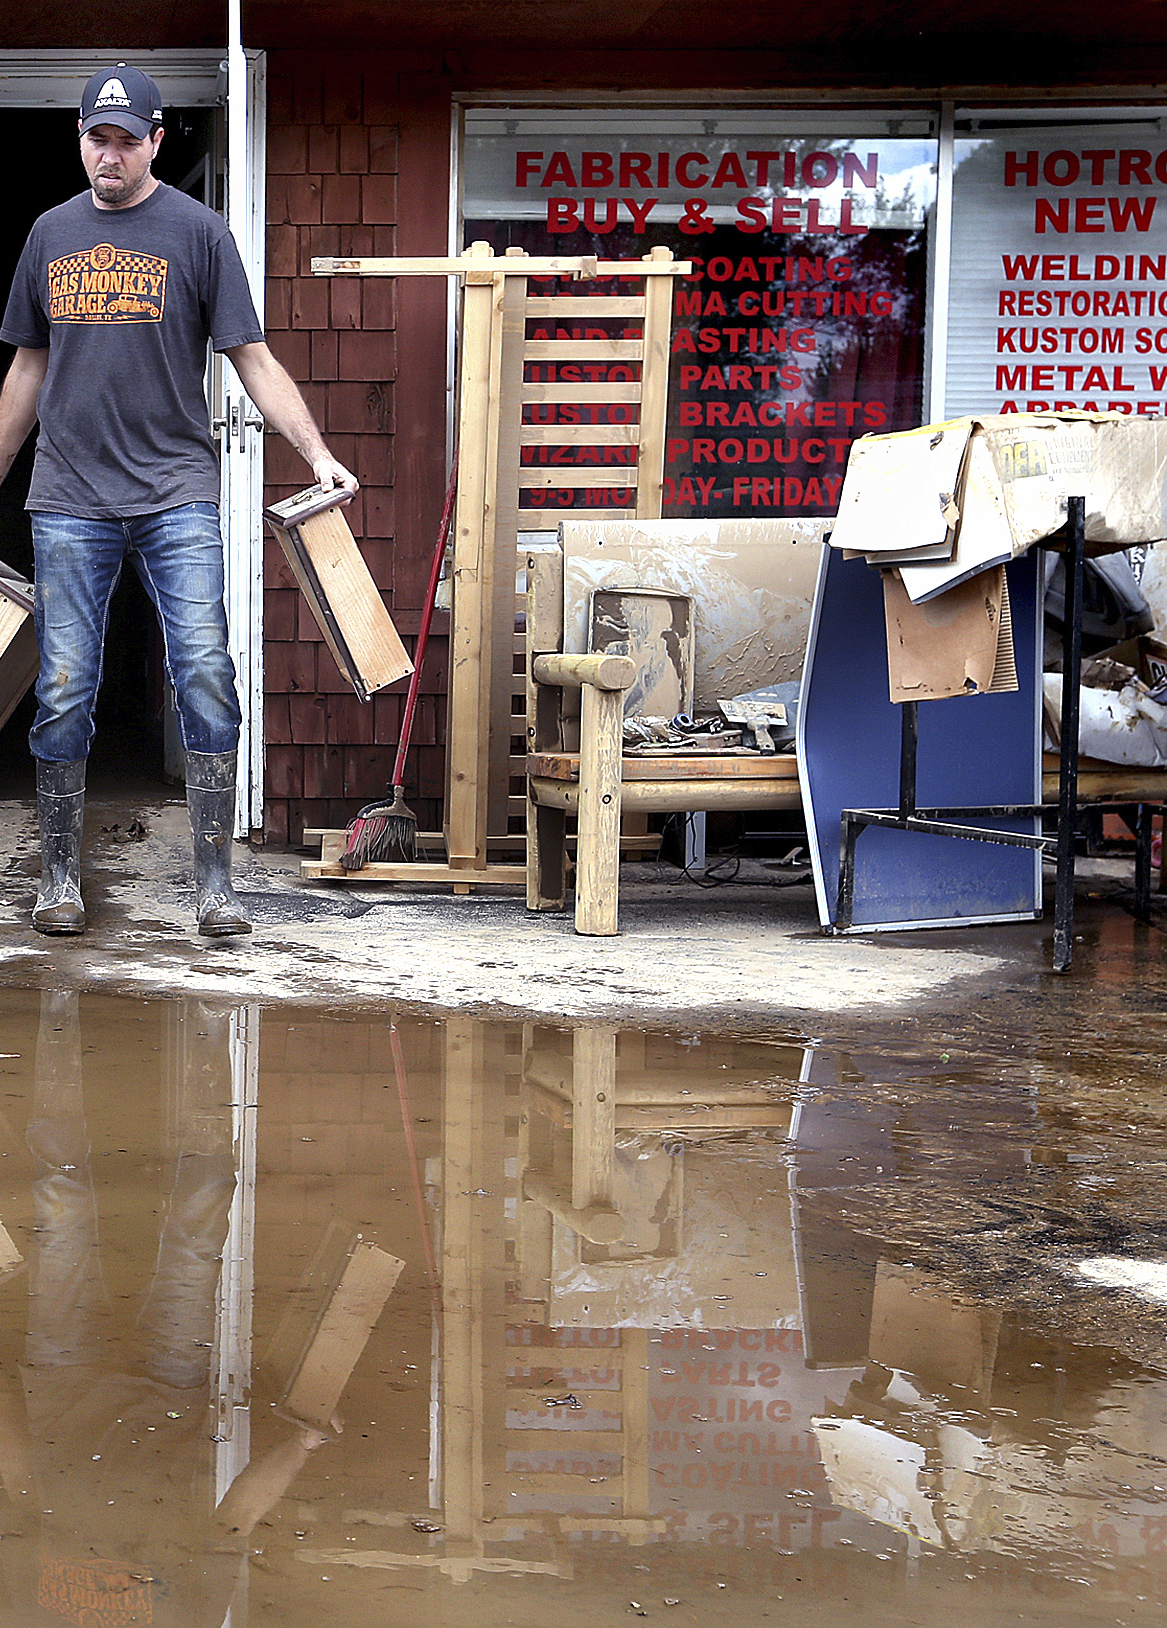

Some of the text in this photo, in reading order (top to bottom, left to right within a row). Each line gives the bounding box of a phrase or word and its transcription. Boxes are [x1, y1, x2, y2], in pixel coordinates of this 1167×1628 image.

[515, 150, 878, 188] FABRICATION
[546, 197, 868, 234] BUY & SELL
[1035, 197, 1157, 234] NEW
[685, 256, 852, 282] COATING
[1002, 254, 1167, 281] WELDIN
[52, 271, 162, 298] GAS MONKEY
[51, 294, 108, 318] GARAGE
[737, 291, 893, 317] CUTTING
[623, 328, 816, 353] ASTING
[997, 327, 1124, 353] KUSTOM
[679, 364, 801, 391] PARTS
[996, 365, 1134, 391] METAL
[679, 401, 886, 427] BRACKETS
[733, 476, 843, 506] FRIDAY
